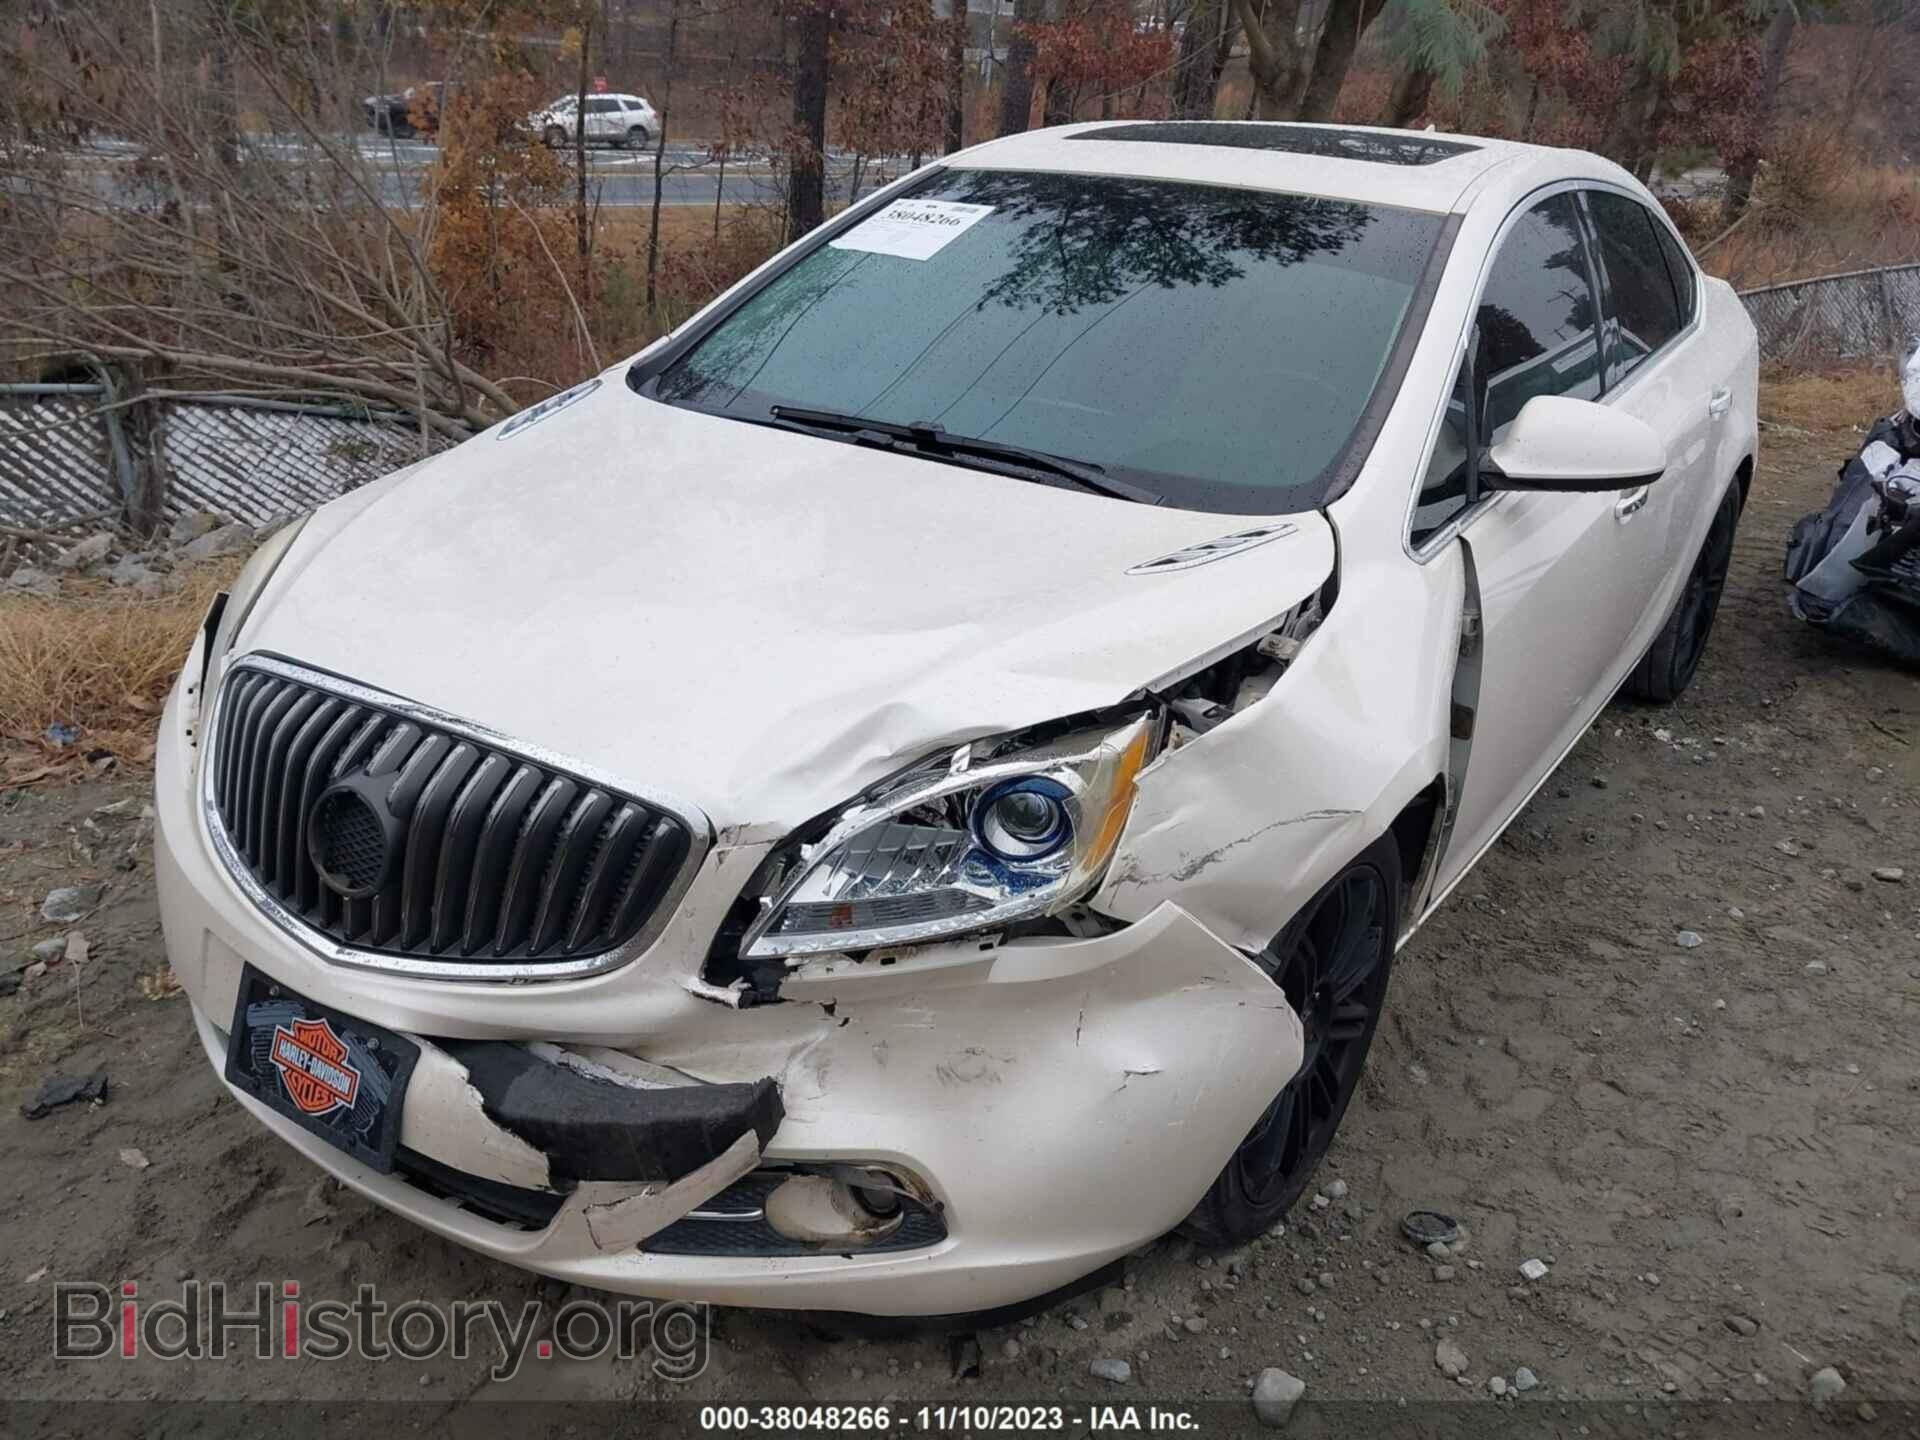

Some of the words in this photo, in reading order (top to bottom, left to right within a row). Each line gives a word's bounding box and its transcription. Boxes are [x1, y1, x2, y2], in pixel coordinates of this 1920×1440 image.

[299, 1028, 340, 1061] MOTOR
[278, 1039, 352, 1095] HARLEY-DAVIDSON
[290, 1071, 330, 1104] CYCLES
